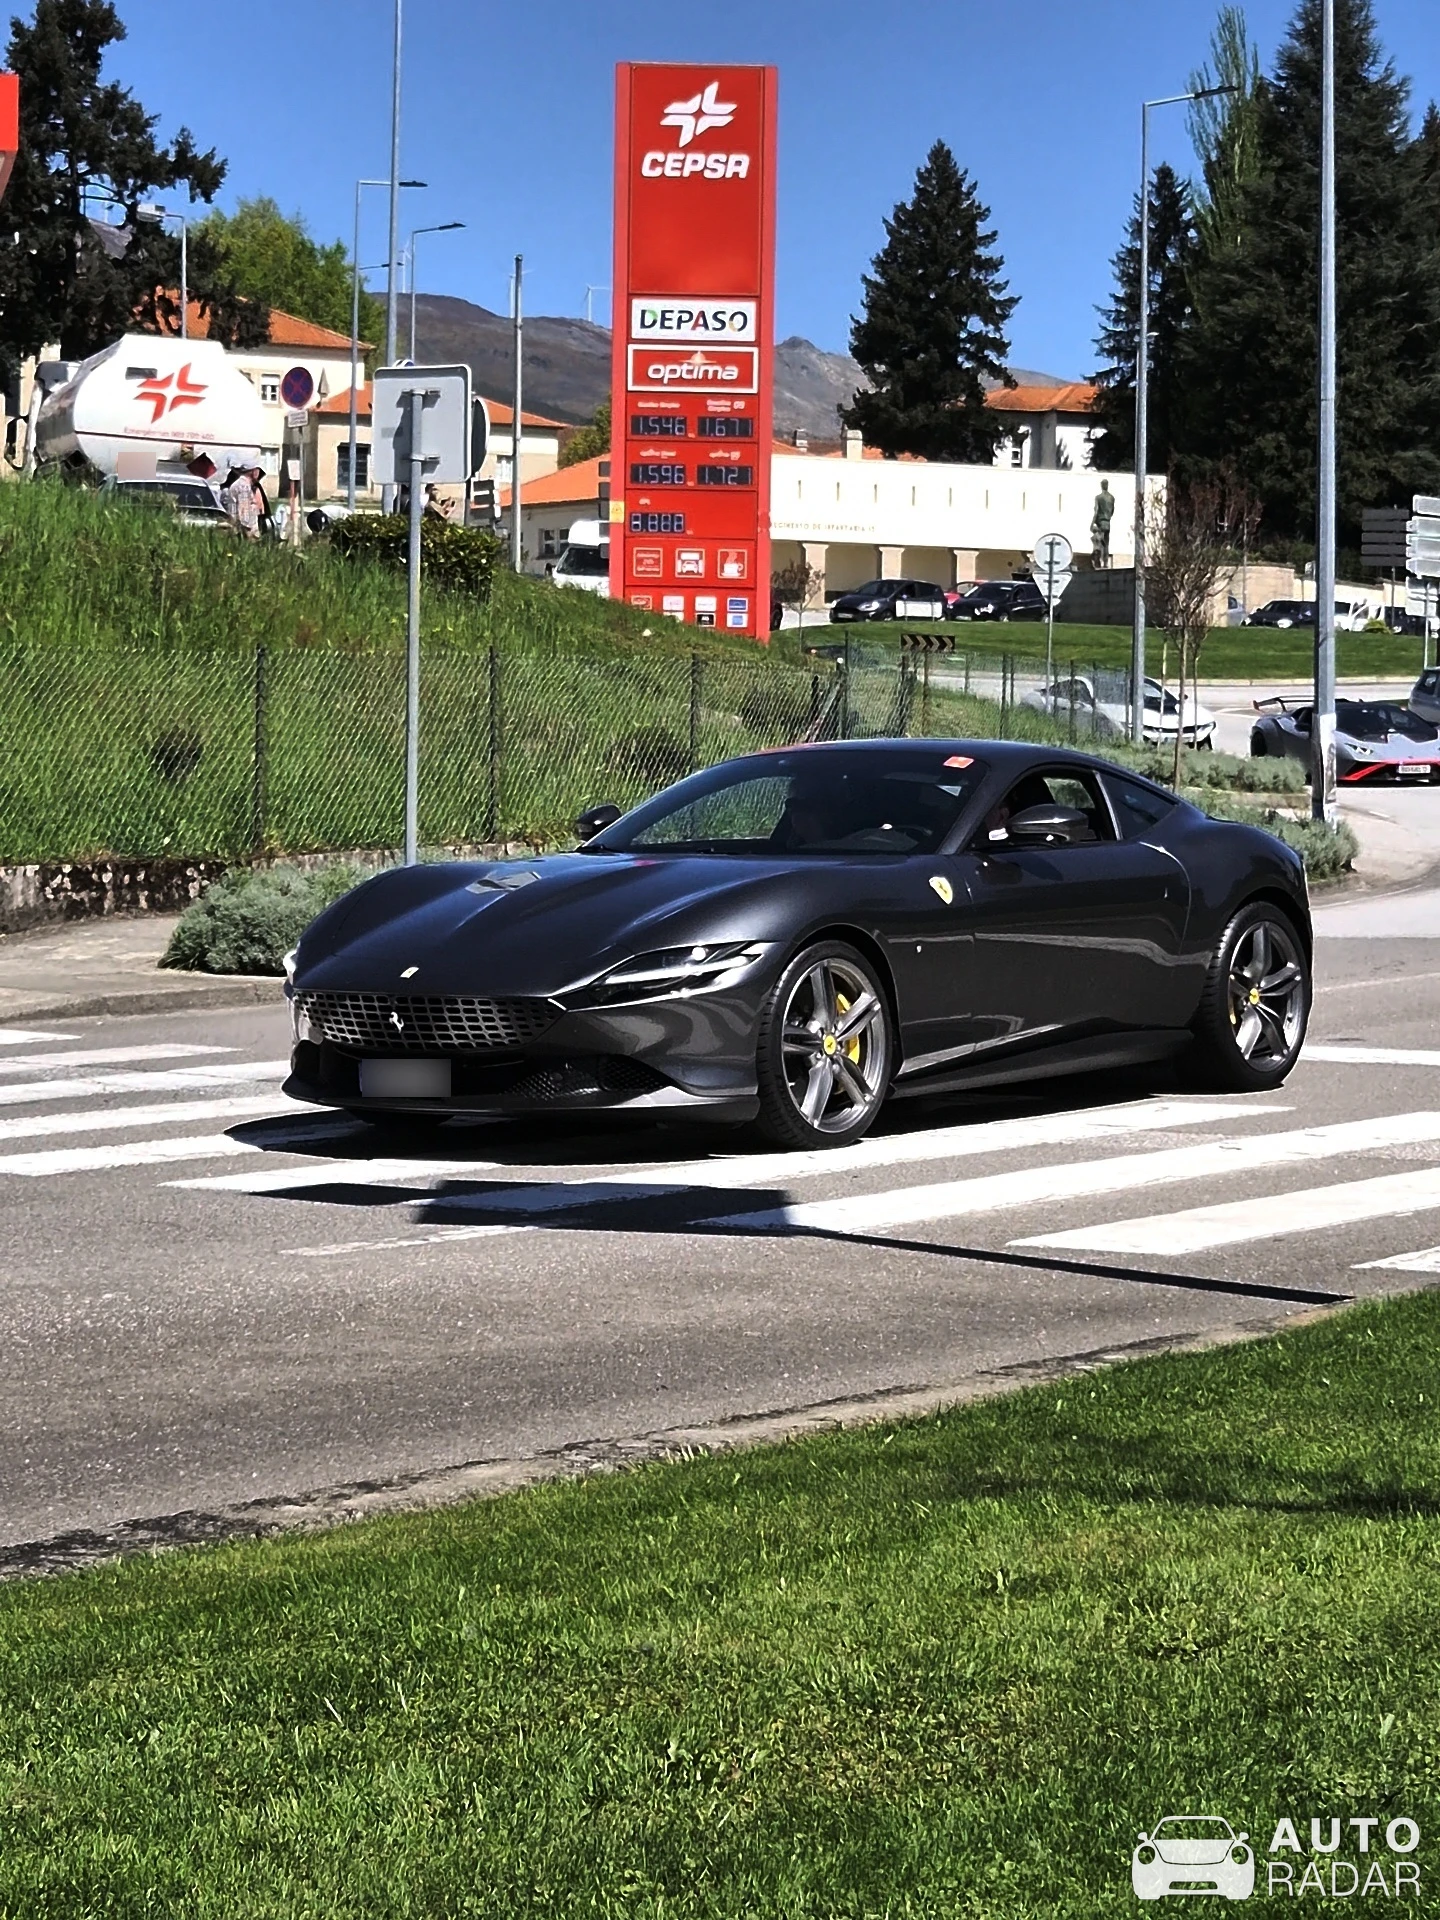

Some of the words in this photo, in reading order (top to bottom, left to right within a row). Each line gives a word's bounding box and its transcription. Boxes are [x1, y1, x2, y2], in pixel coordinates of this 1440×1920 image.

[641, 151, 750, 179] CEPSA
[639, 309, 748, 333] DEPASO
[647, 362, 739, 384] optima
[639, 416, 686, 436] 1.546
[705, 418, 752, 437] 1.671
[638, 465, 685, 484] 1.596
[705, 466, 752, 485] 1.721
